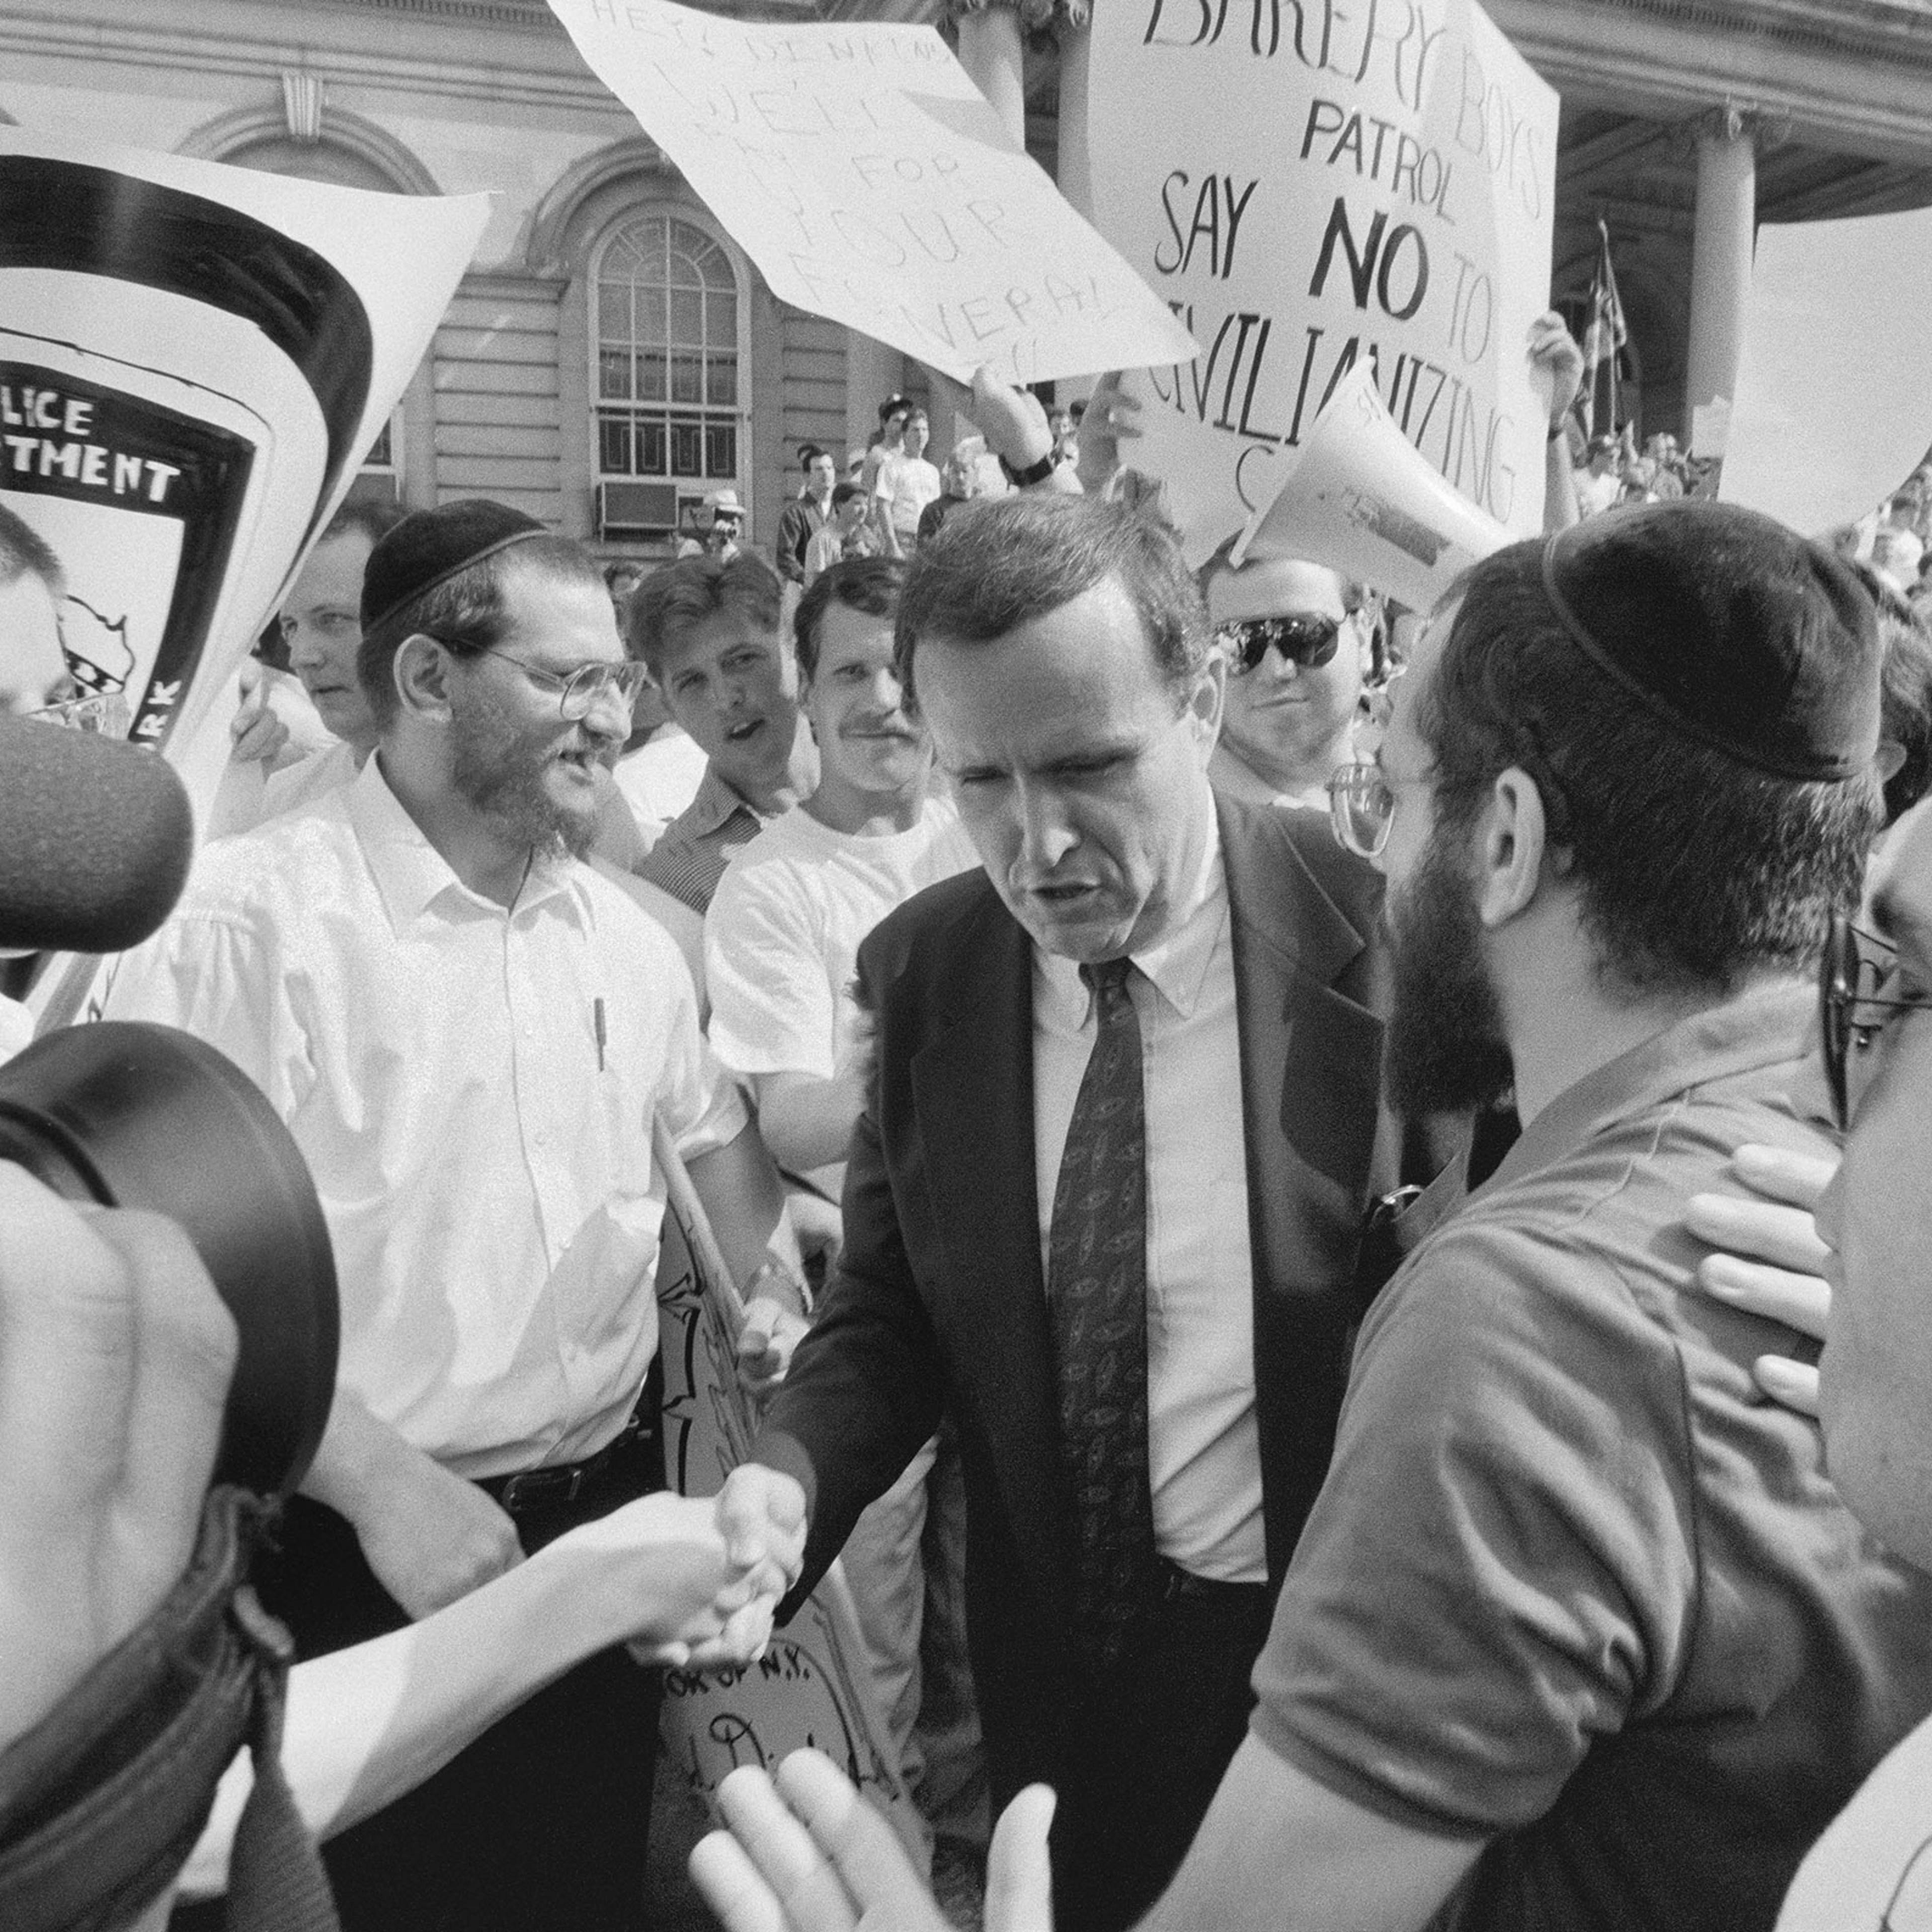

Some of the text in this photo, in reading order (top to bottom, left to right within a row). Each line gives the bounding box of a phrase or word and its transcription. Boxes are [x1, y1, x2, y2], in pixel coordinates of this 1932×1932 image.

[1300, 99, 1456, 225] PATROL
[1455, 43, 1541, 220] BOYS
[1154, 170, 1493, 364] SAY NO TO
[0, 384, 95, 435] LICE
[1147, 300, 1515, 524] IVILIANIZING
[135, 680, 182, 751] RK
